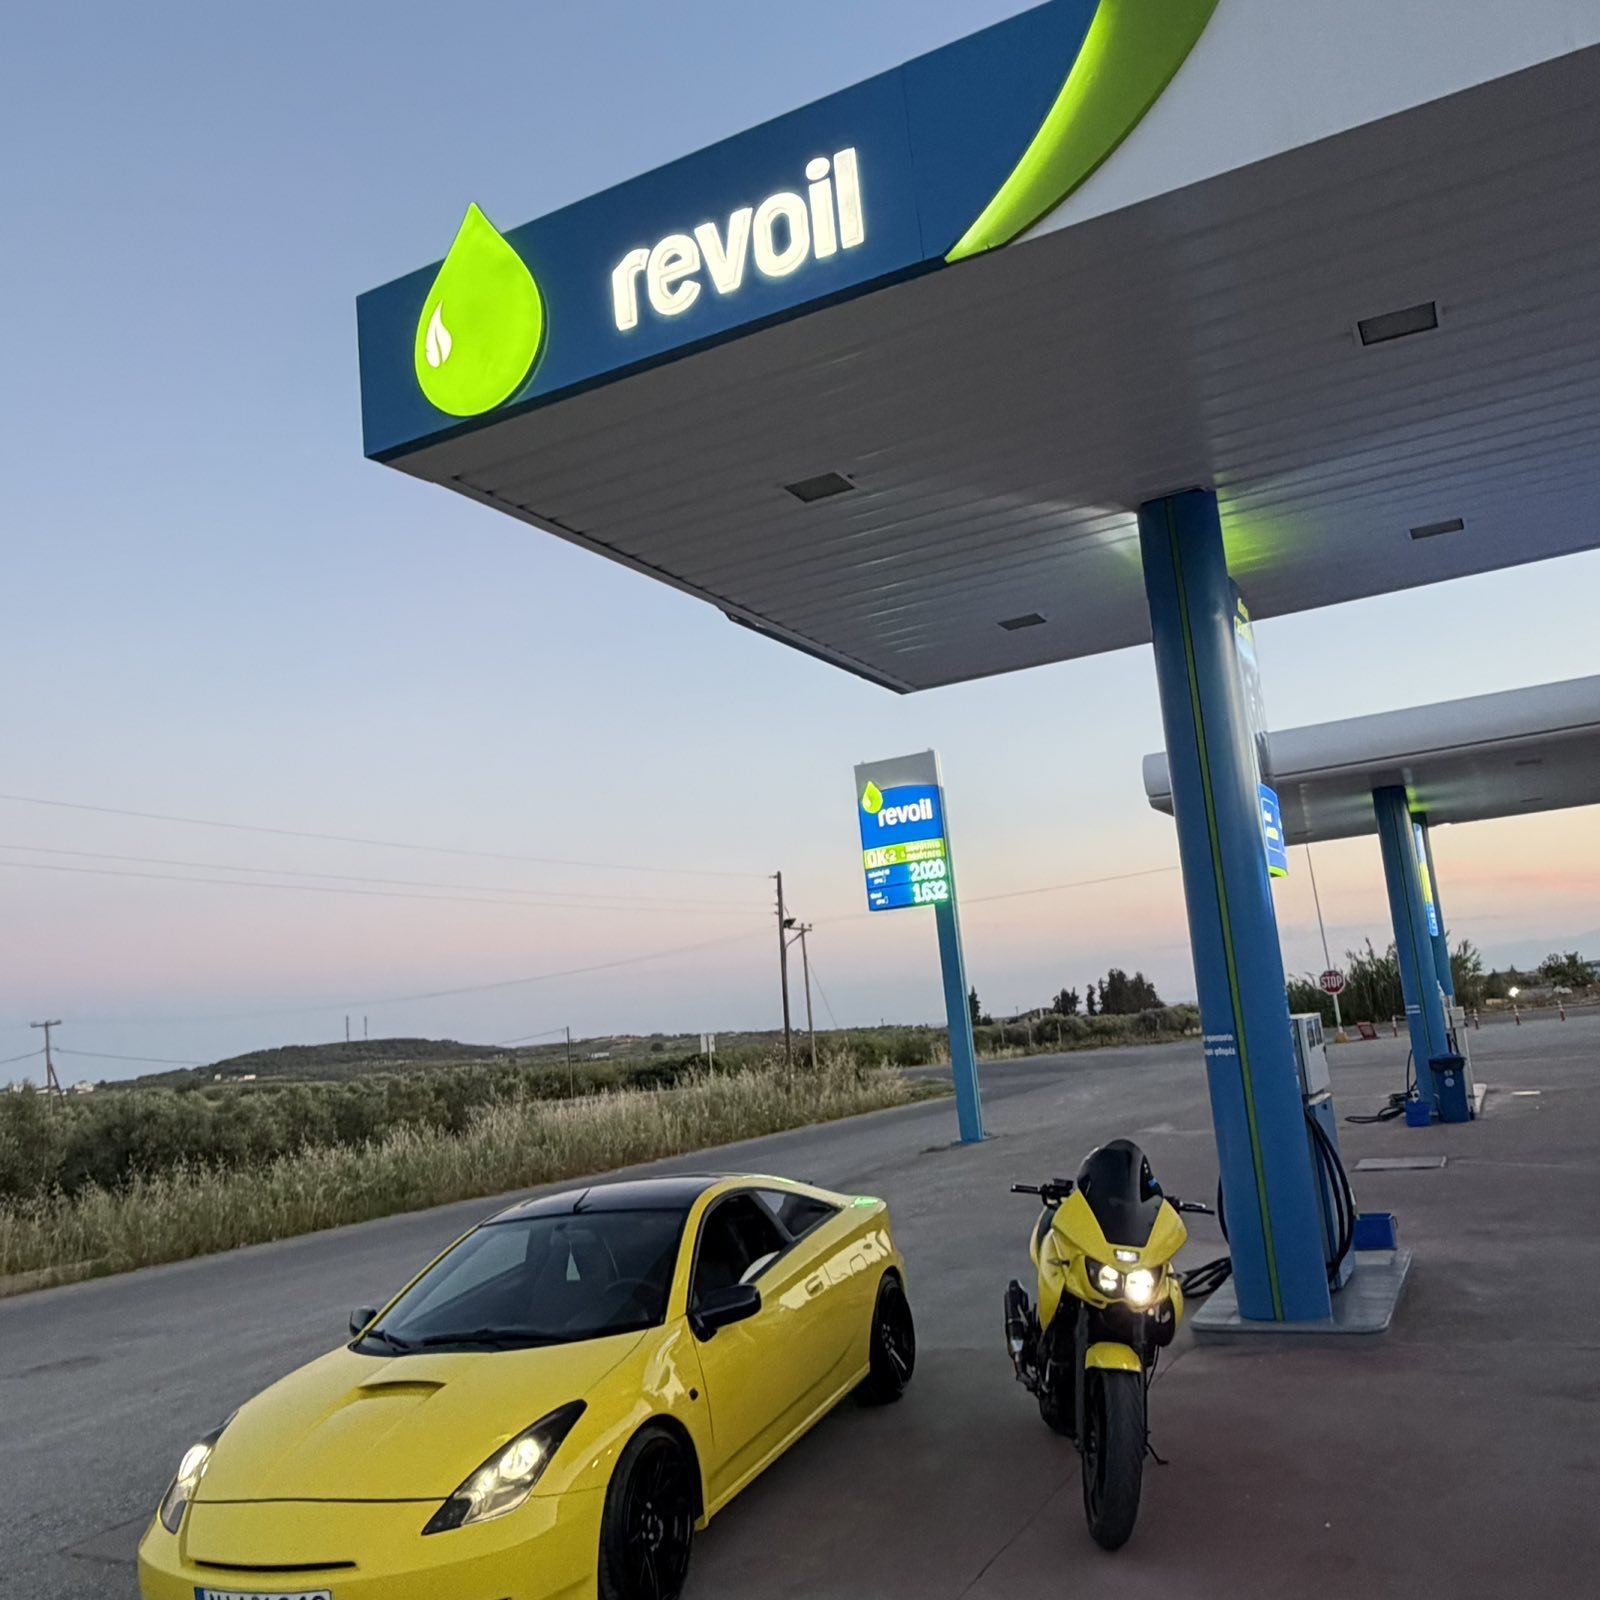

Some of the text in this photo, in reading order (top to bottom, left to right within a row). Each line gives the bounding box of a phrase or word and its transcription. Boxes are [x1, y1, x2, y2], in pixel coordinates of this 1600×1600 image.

[612, 146, 865, 331] revoil
[877, 798, 933, 827] revoil
[1320, 975, 1342, 989] STOP
